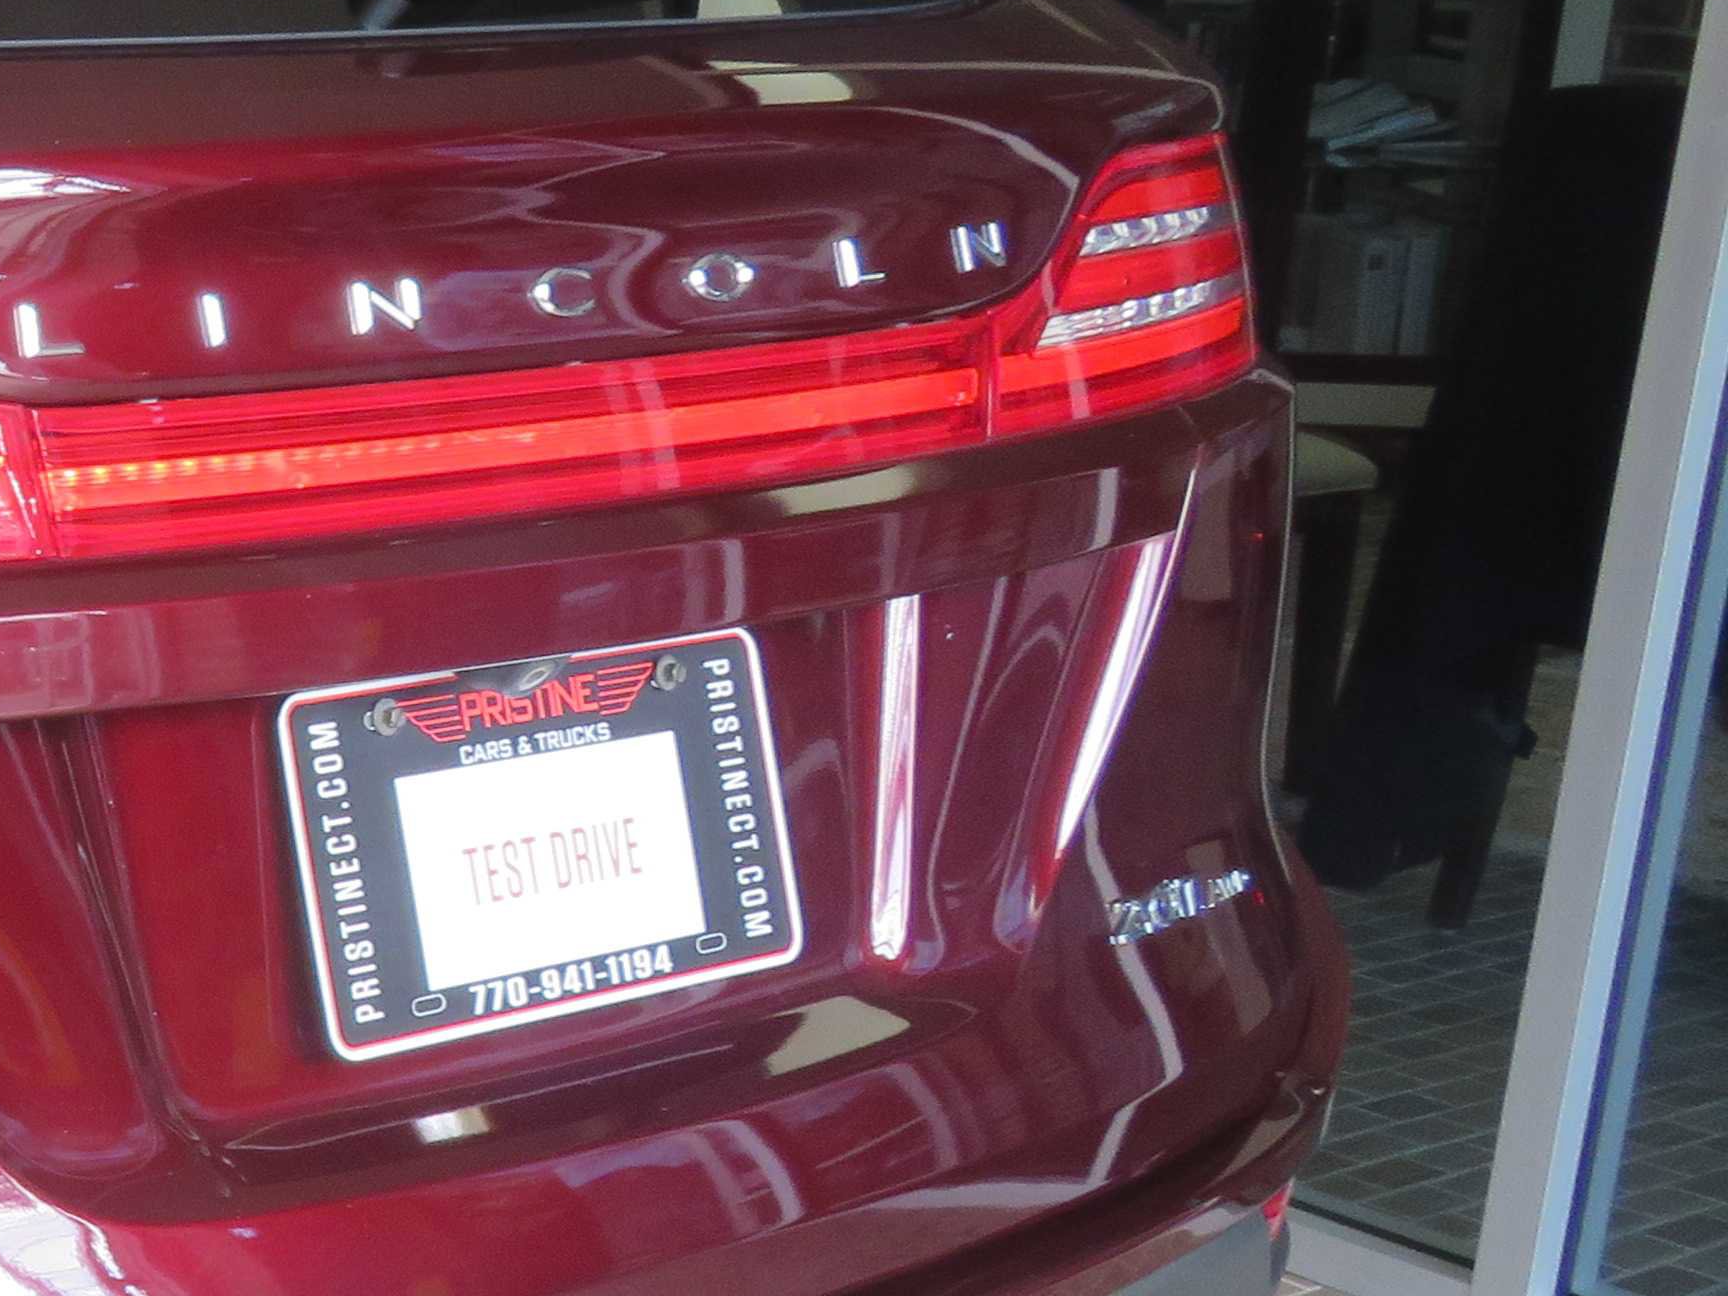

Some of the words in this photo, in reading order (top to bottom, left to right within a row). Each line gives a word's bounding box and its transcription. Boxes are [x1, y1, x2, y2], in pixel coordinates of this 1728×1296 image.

[13, 219, 1006, 360] LINCOLN
[457, 672, 599, 730] PRISTINE
[458, 741, 513, 766] CARS
[517, 736, 534, 756] &
[534, 721, 612, 752] TRUCKS
[701, 656, 773, 940] PRISTINECT.COM
[306, 719, 385, 1025] PRISTINECT.COM
[462, 834, 539, 905] TEST
[550, 817, 644, 889] DRIVE
[469, 943, 674, 1016] 770-941-1194
